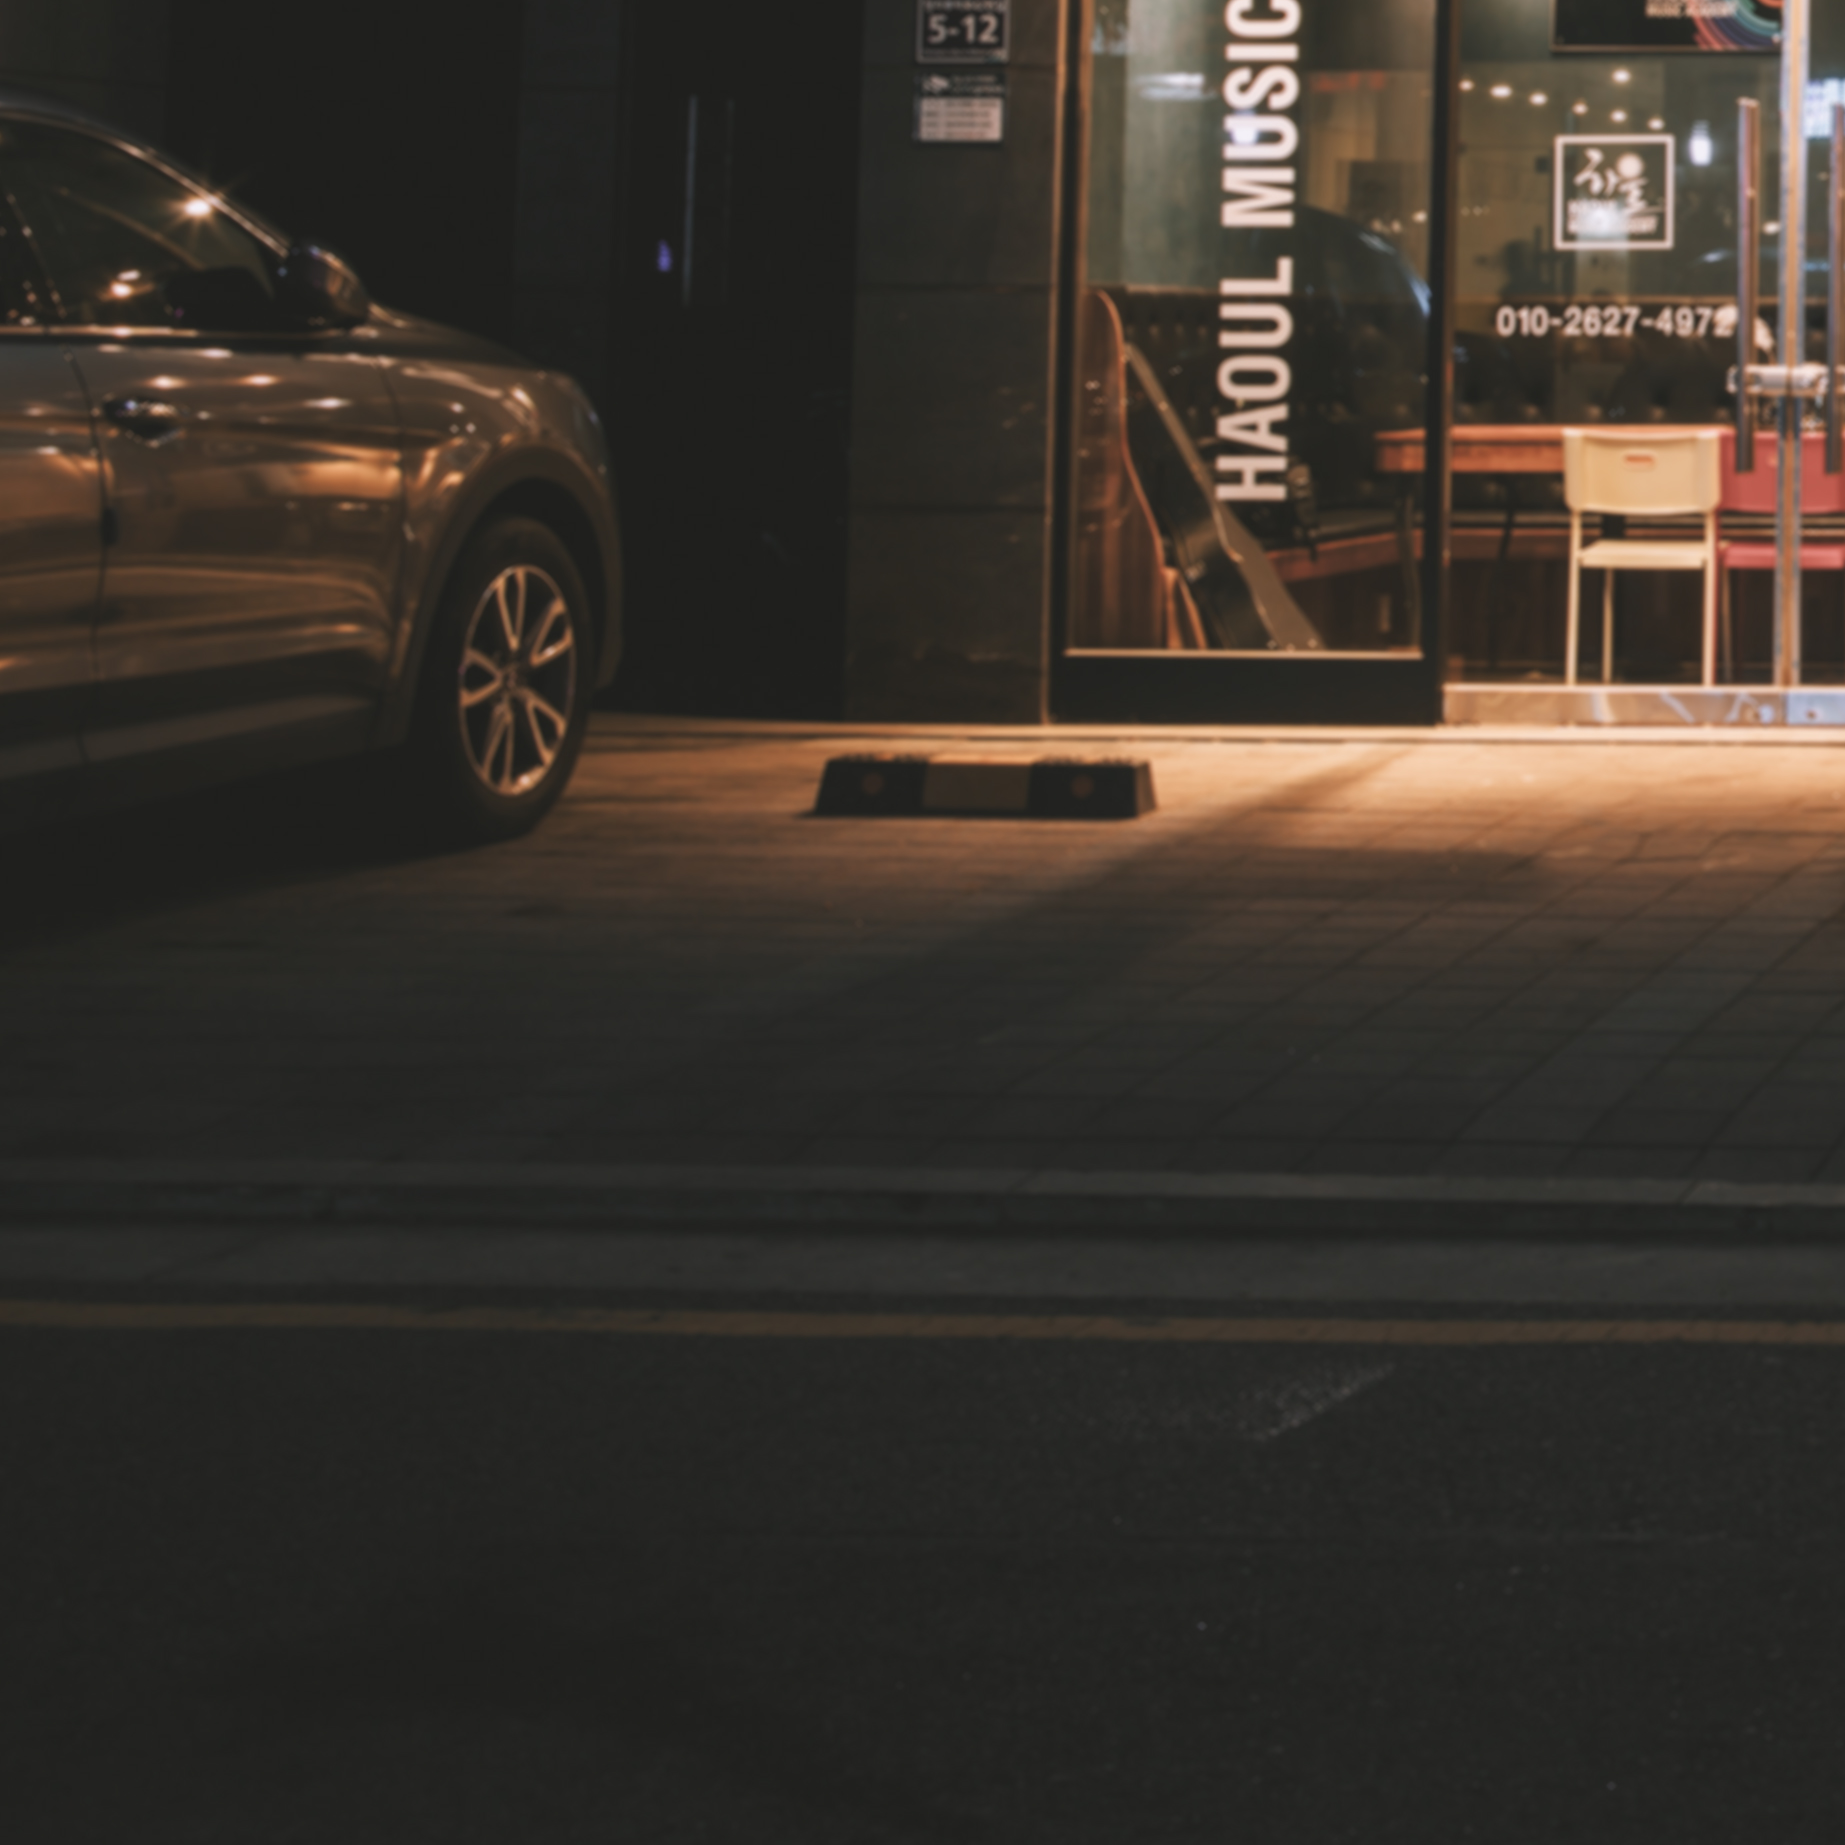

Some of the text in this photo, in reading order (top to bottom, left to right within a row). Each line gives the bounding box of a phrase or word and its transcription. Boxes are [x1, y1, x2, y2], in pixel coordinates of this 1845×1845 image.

[927, 13, 999, 44] 5-12
[1496, 305, 1738, 338] 010-2627-4972
[1215, 256, 1294, 502] HAOUL
